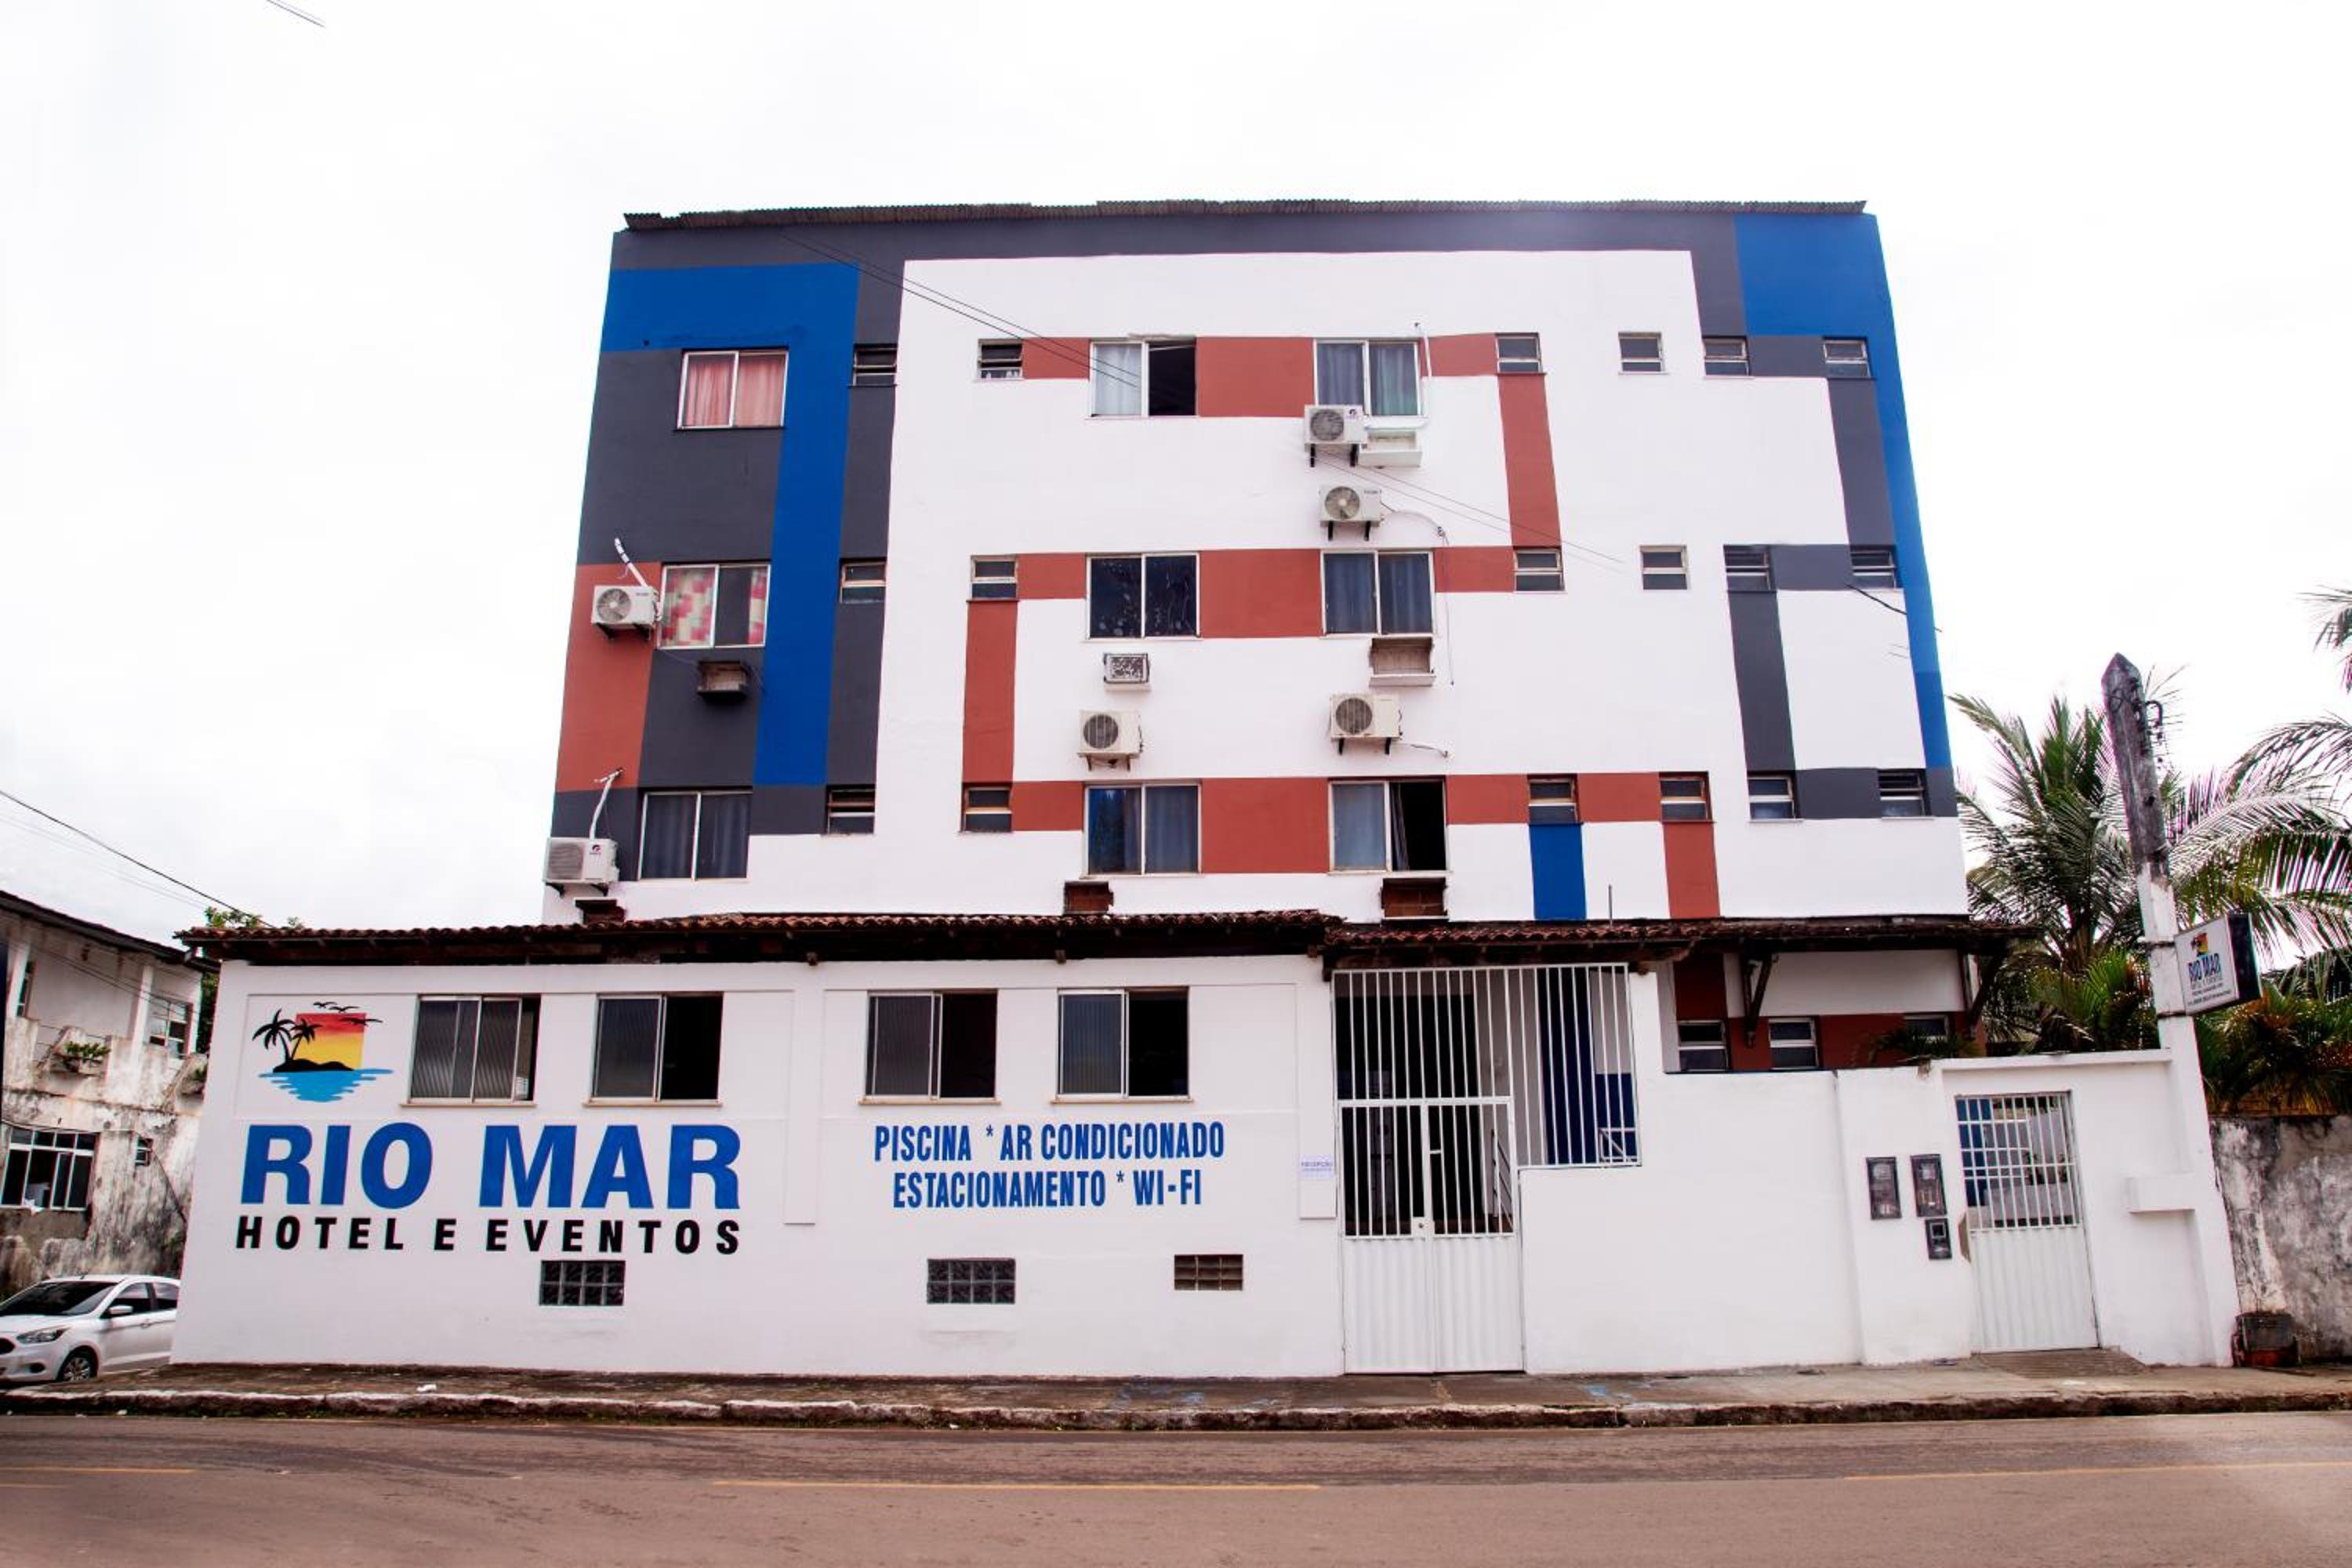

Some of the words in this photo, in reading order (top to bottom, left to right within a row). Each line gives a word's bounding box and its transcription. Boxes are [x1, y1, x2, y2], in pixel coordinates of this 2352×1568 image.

[874, 1125, 971, 1162] PISCINA
[1000, 1124, 1033, 1161] AR
[1040, 1121, 1225, 1161] CONDICIONADO
[240, 1122, 433, 1210] RIO
[478, 1124, 741, 1210] MAR
[893, 1170, 1105, 1208] ESTACIONAMENTO
[1133, 1169, 1201, 1206] WI-FI
[235, 1214, 404, 1250] HOTEL
[433, 1218, 457, 1252] E
[485, 1218, 740, 1255] EVENTOS
